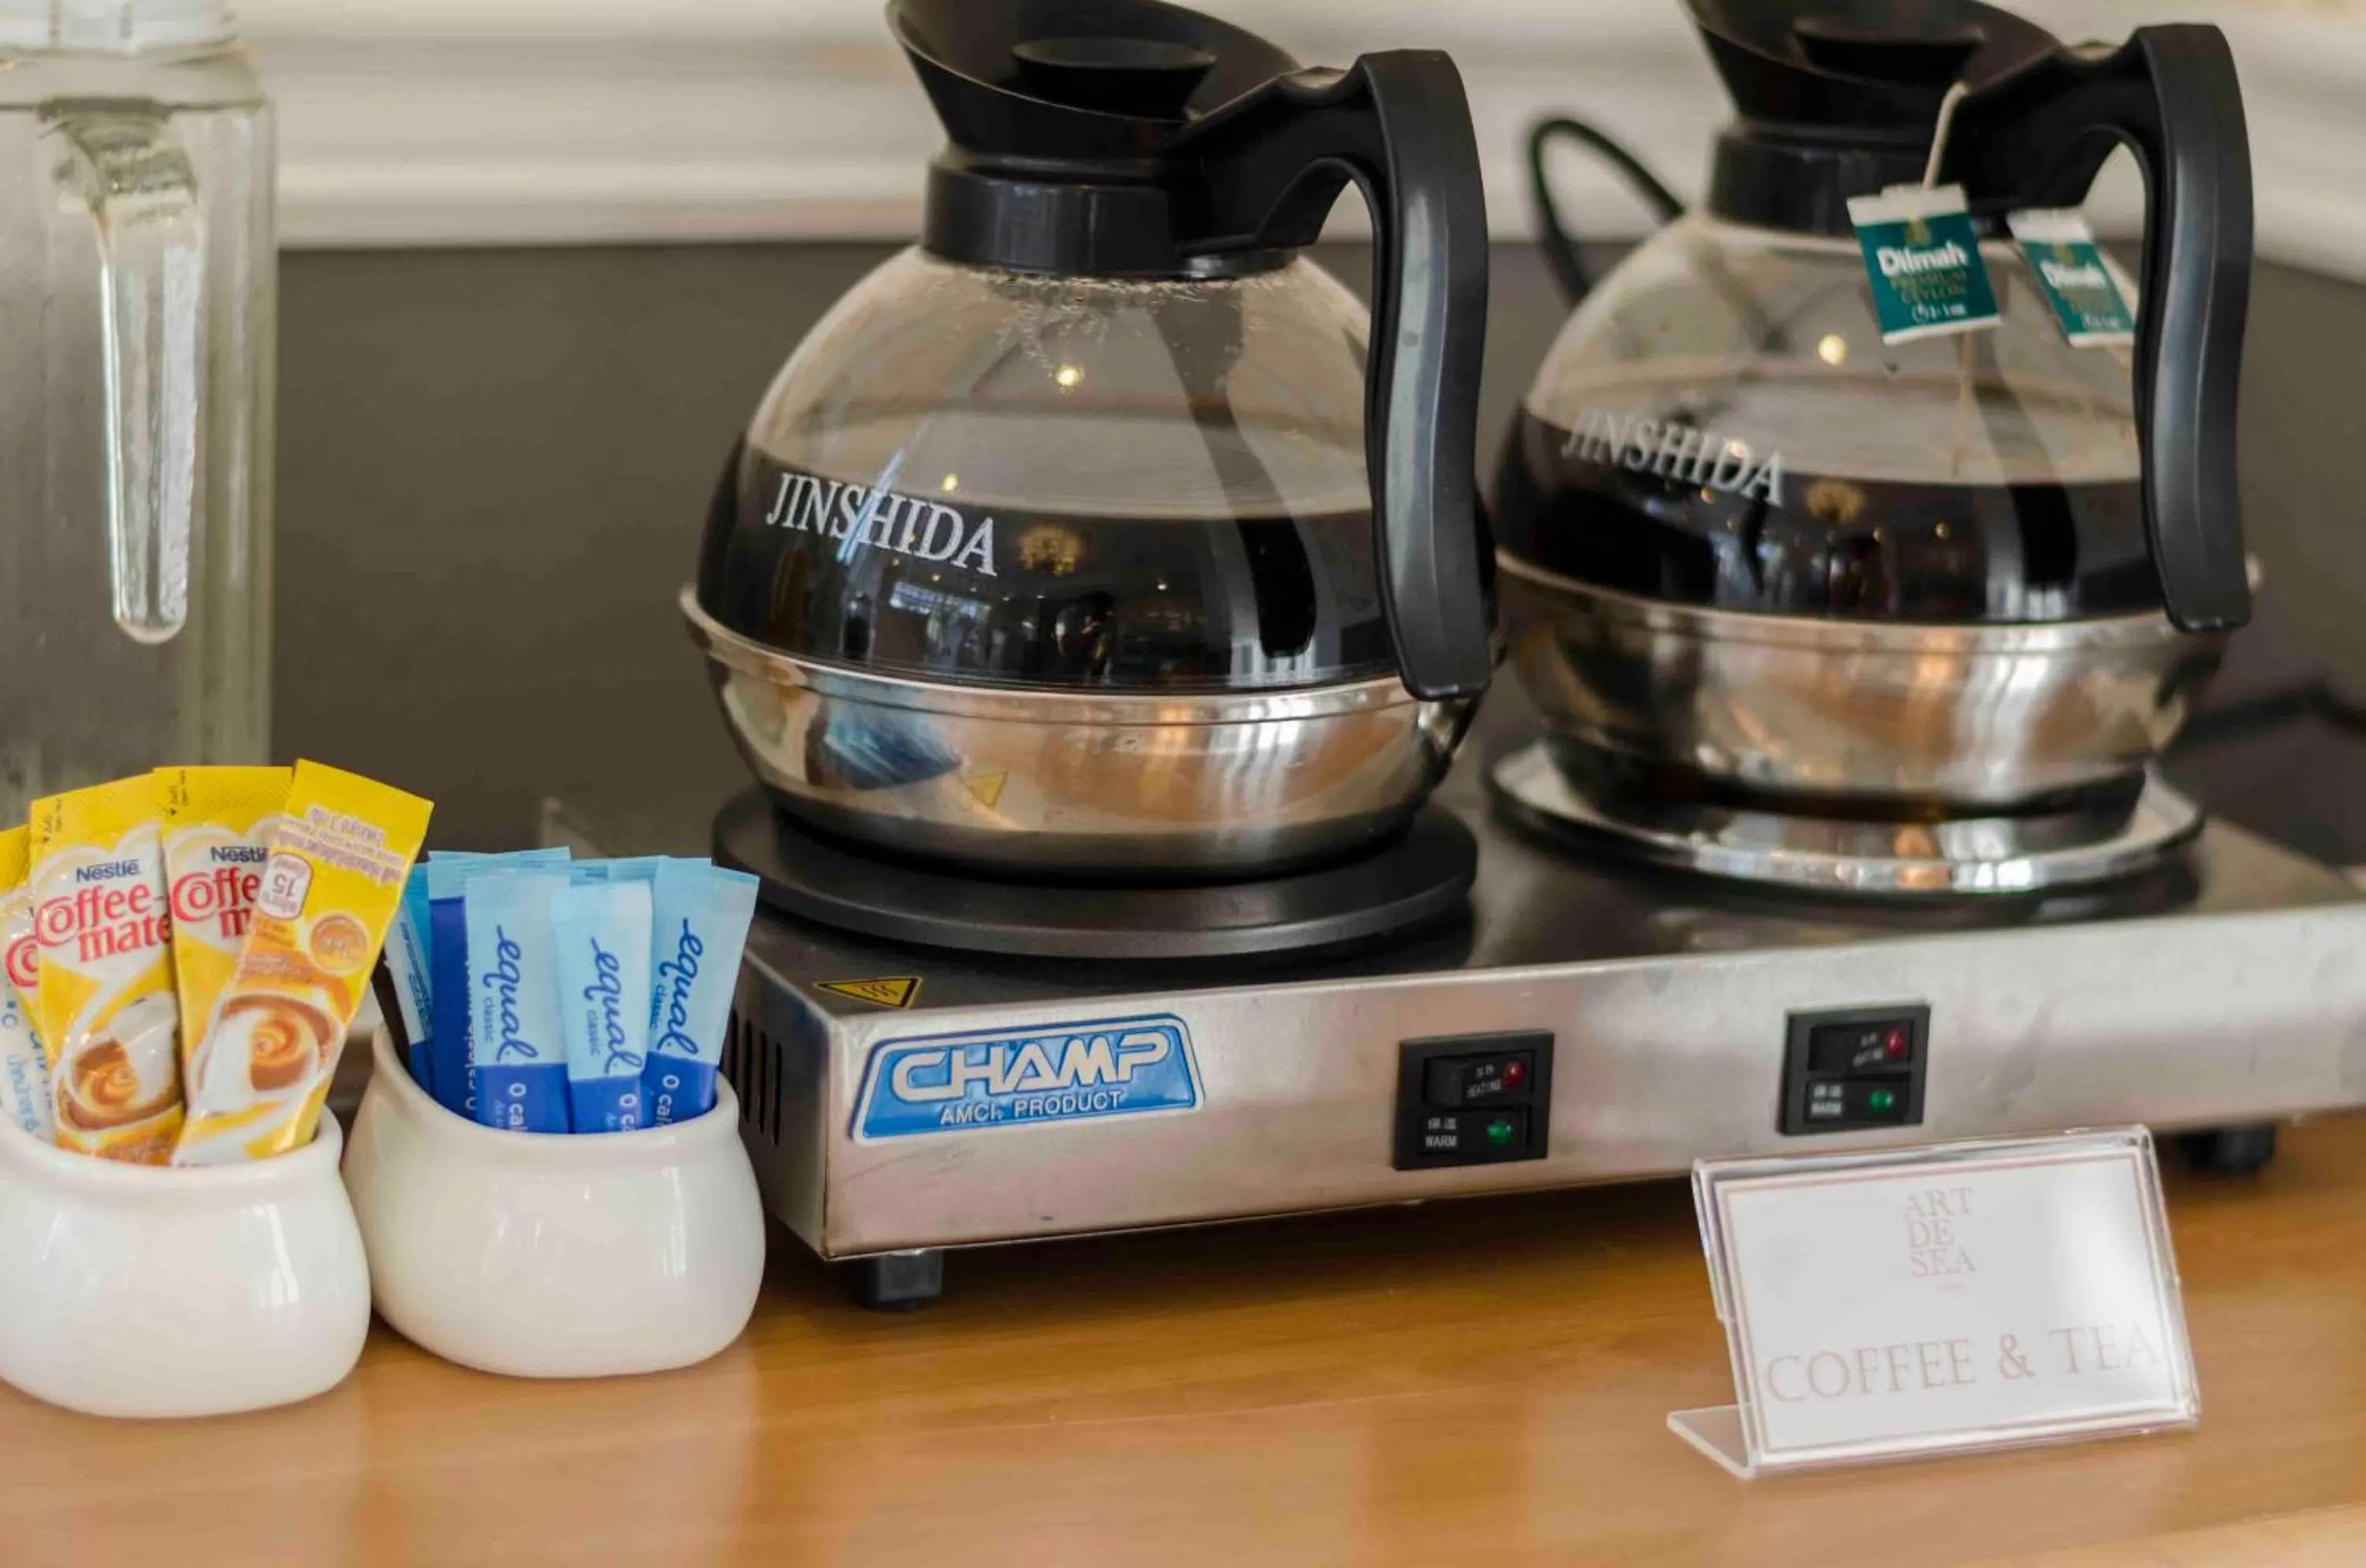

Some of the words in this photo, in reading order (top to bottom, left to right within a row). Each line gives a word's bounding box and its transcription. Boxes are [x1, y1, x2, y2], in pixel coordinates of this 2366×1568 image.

[1876, 239, 1968, 278] Dilmah
[1562, 408, 1783, 507] JINSHIDA
[766, 472, 998, 577] JINSHIDA
[170, 865, 262, 922] Coffe
[482, 924, 539, 1062] equal
[583, 937, 644, 1074] equal
[659, 917, 703, 1056] equal
[483, 995, 495, 1043] classic
[585, 1010, 602, 1055] classic
[891, 1031, 1170, 1103] CHAMP
[1013, 1090, 1122, 1118] PRODUCT
[1906, 1186, 1973, 1219] ART
[1908, 1219, 1954, 1249] DE
[1910, 1244, 1977, 1278] SEA
[1765, 1338, 1976, 1403] COFFEE
[1997, 1333, 2036, 1381] &
[2049, 1321, 2163, 1376] TEA
